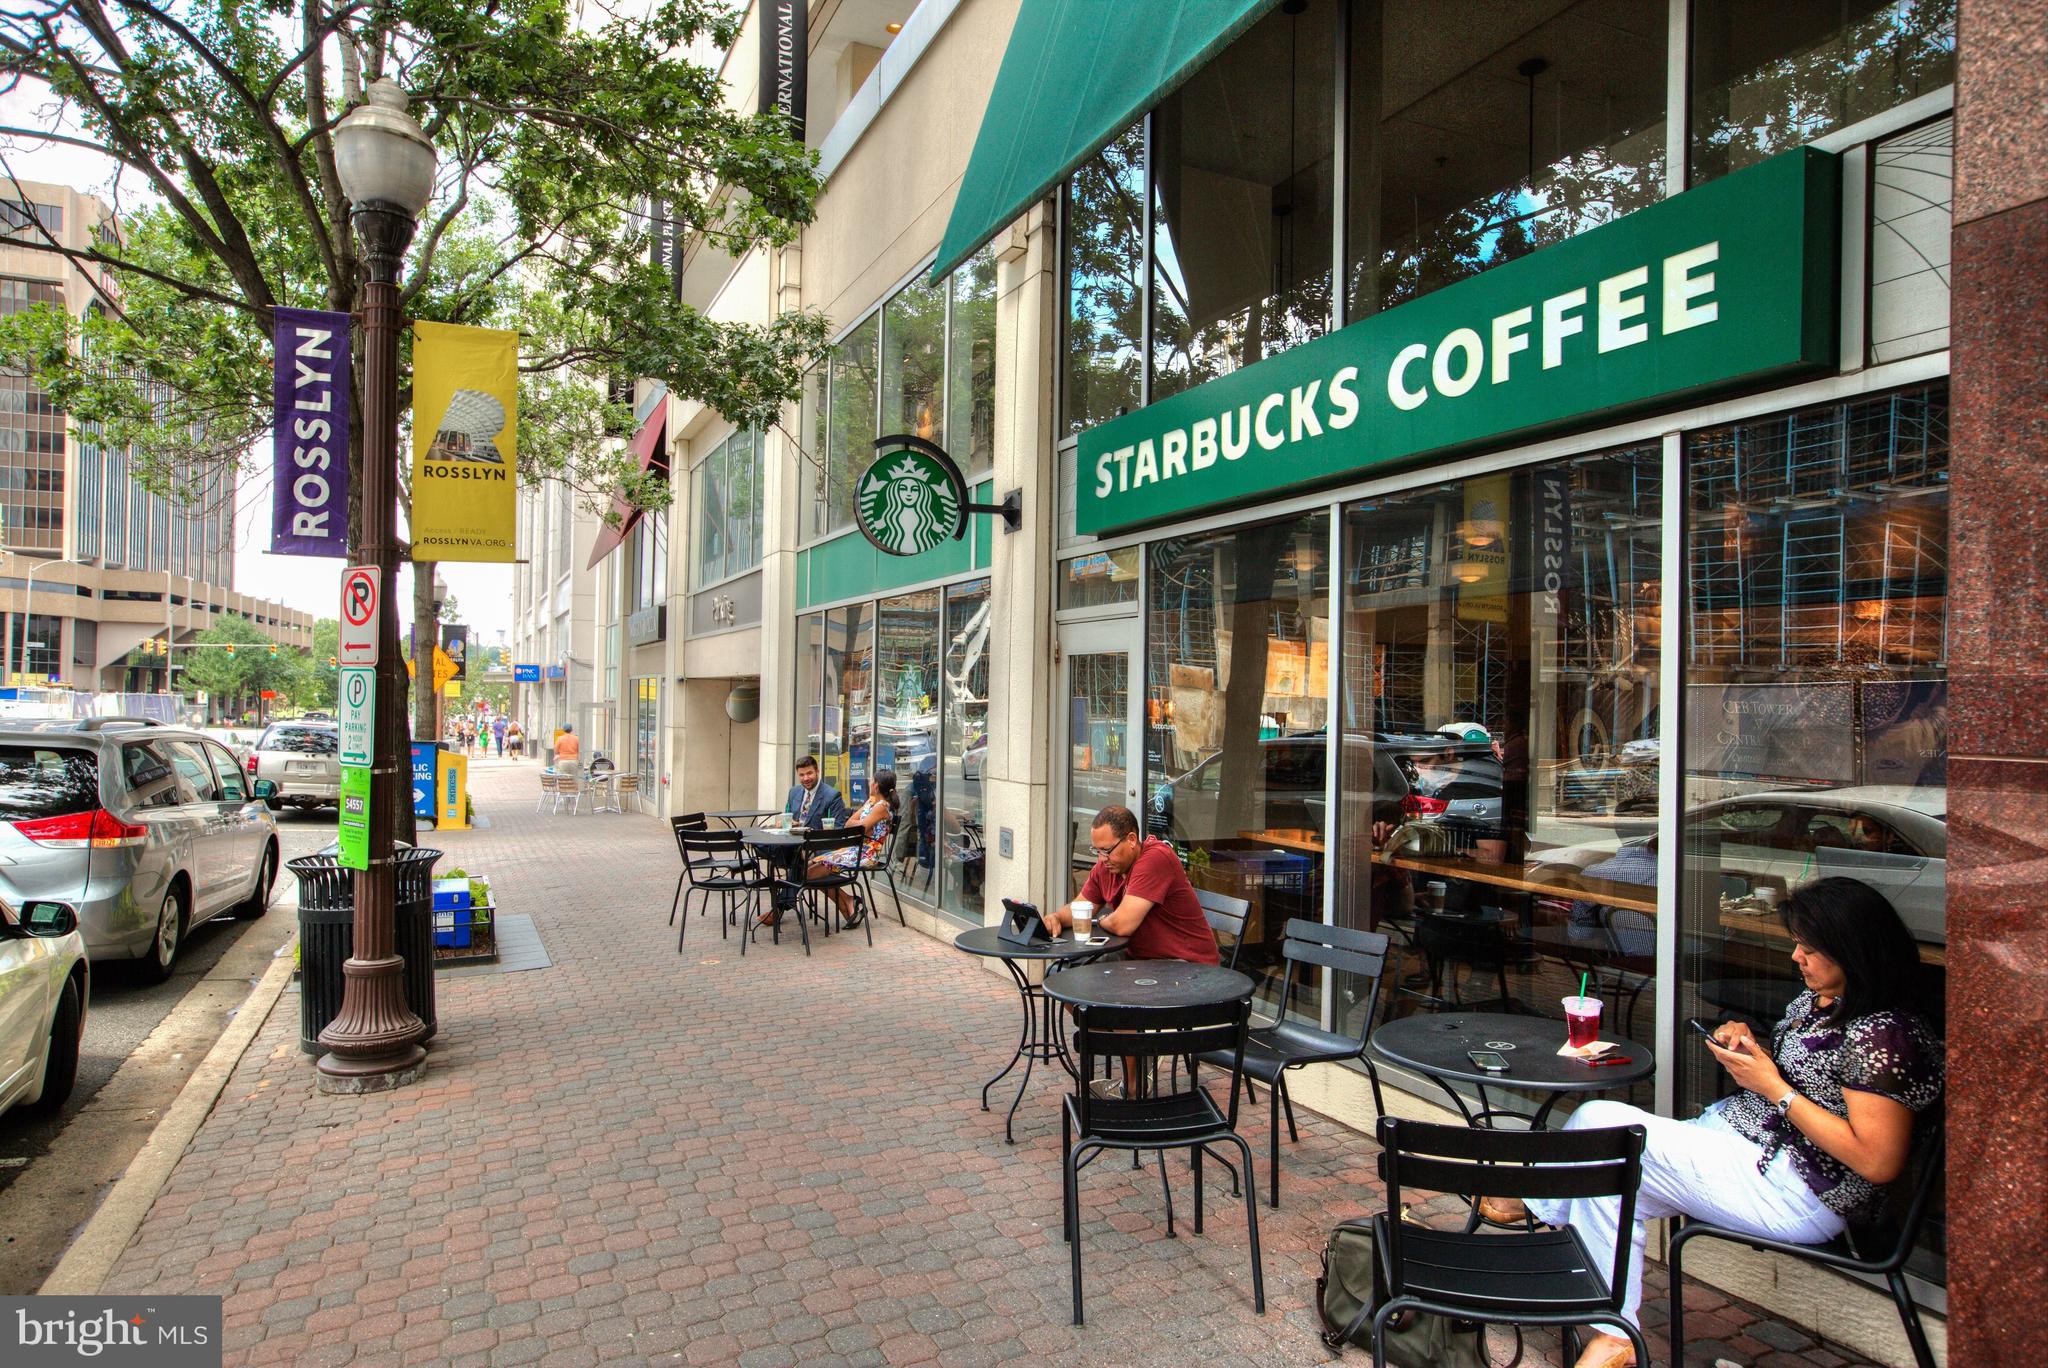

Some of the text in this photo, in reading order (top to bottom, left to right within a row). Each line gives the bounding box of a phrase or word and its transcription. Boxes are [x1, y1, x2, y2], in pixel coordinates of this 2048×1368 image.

[1095, 240, 1720, 499] STARBUCKS COFFEE
[292, 327, 332, 538] ROSSLYN
[423, 465, 506, 481] ROSSLYN
[350, 709, 361, 720] PAY
[344, 721, 367, 734] PARKING
[347, 735, 352, 750] 2
[412, 763, 429, 772] LIC
